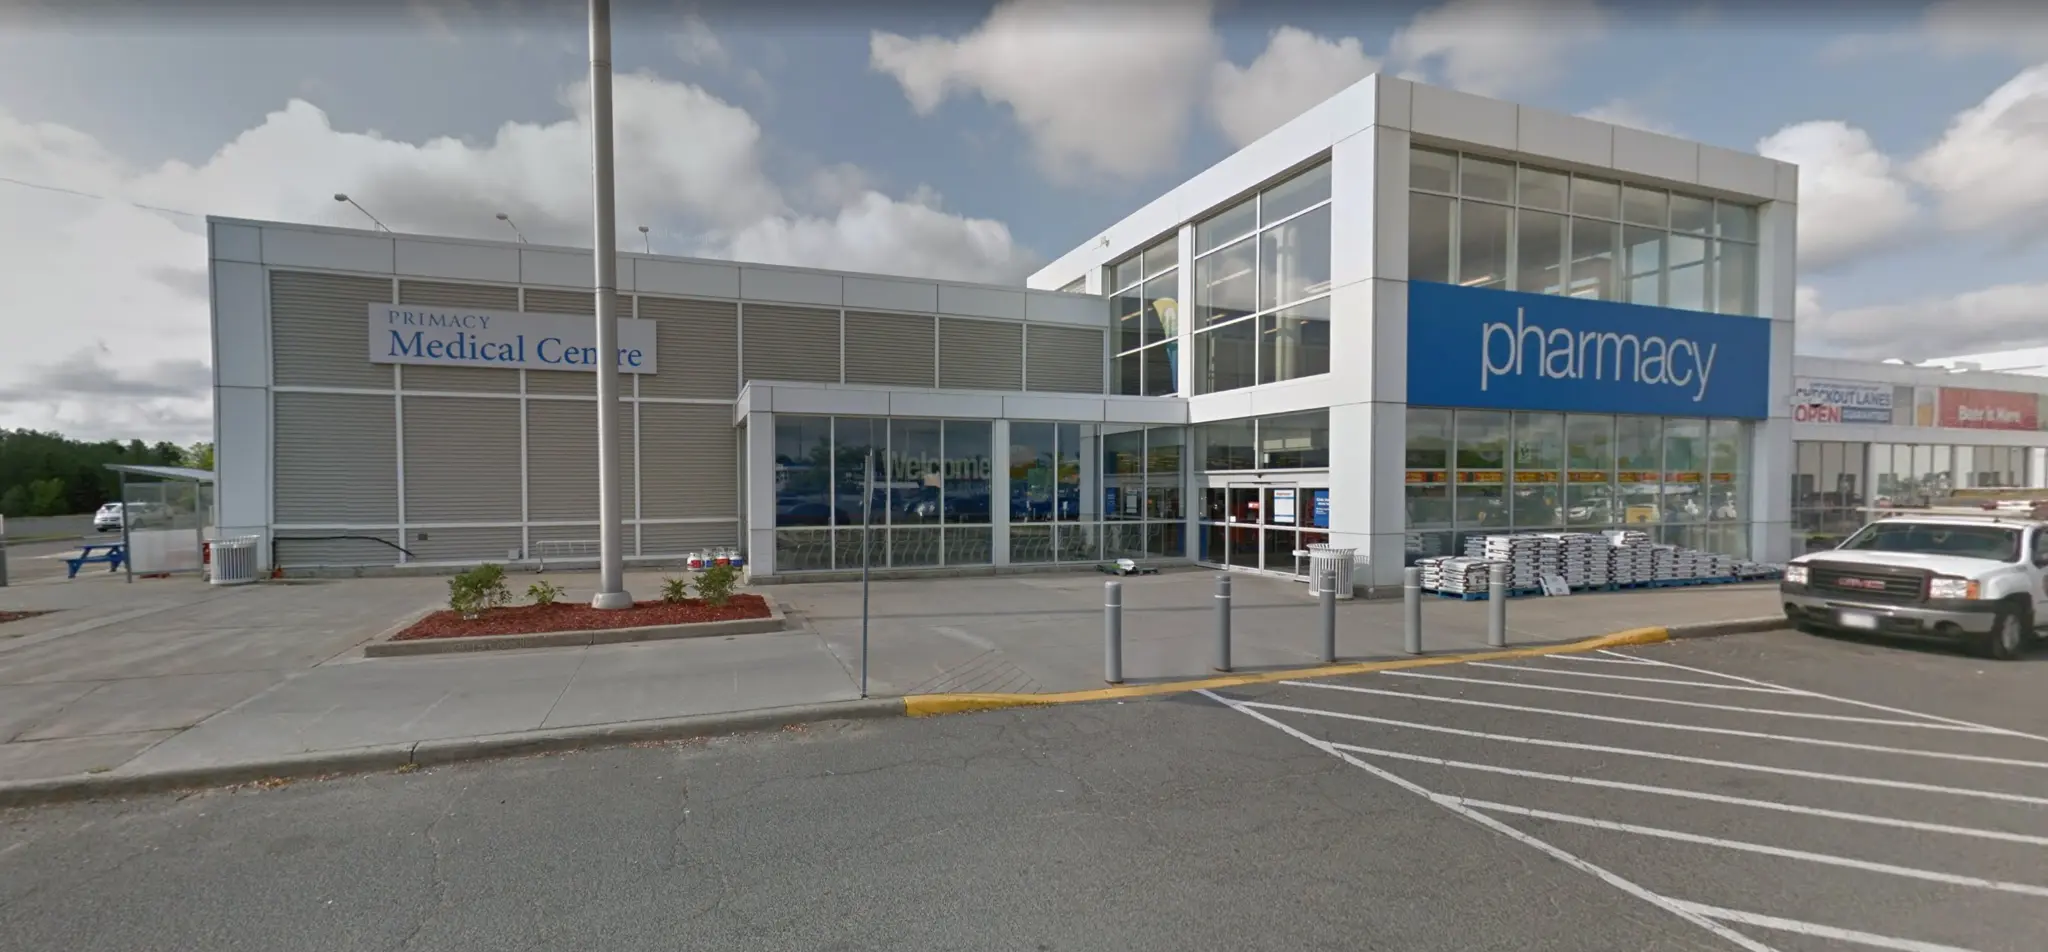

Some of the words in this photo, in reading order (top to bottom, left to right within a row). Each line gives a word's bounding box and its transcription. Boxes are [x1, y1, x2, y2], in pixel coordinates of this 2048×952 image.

[387, 309, 490, 330] PRIMACY
[388, 329, 526, 362] Medical
[536, 337, 643, 367] Cenre
[1481, 308, 1717, 401] pharmacy
[1795, 404, 1840, 423] OPEN
[881, 451, 991, 479] Welcome
